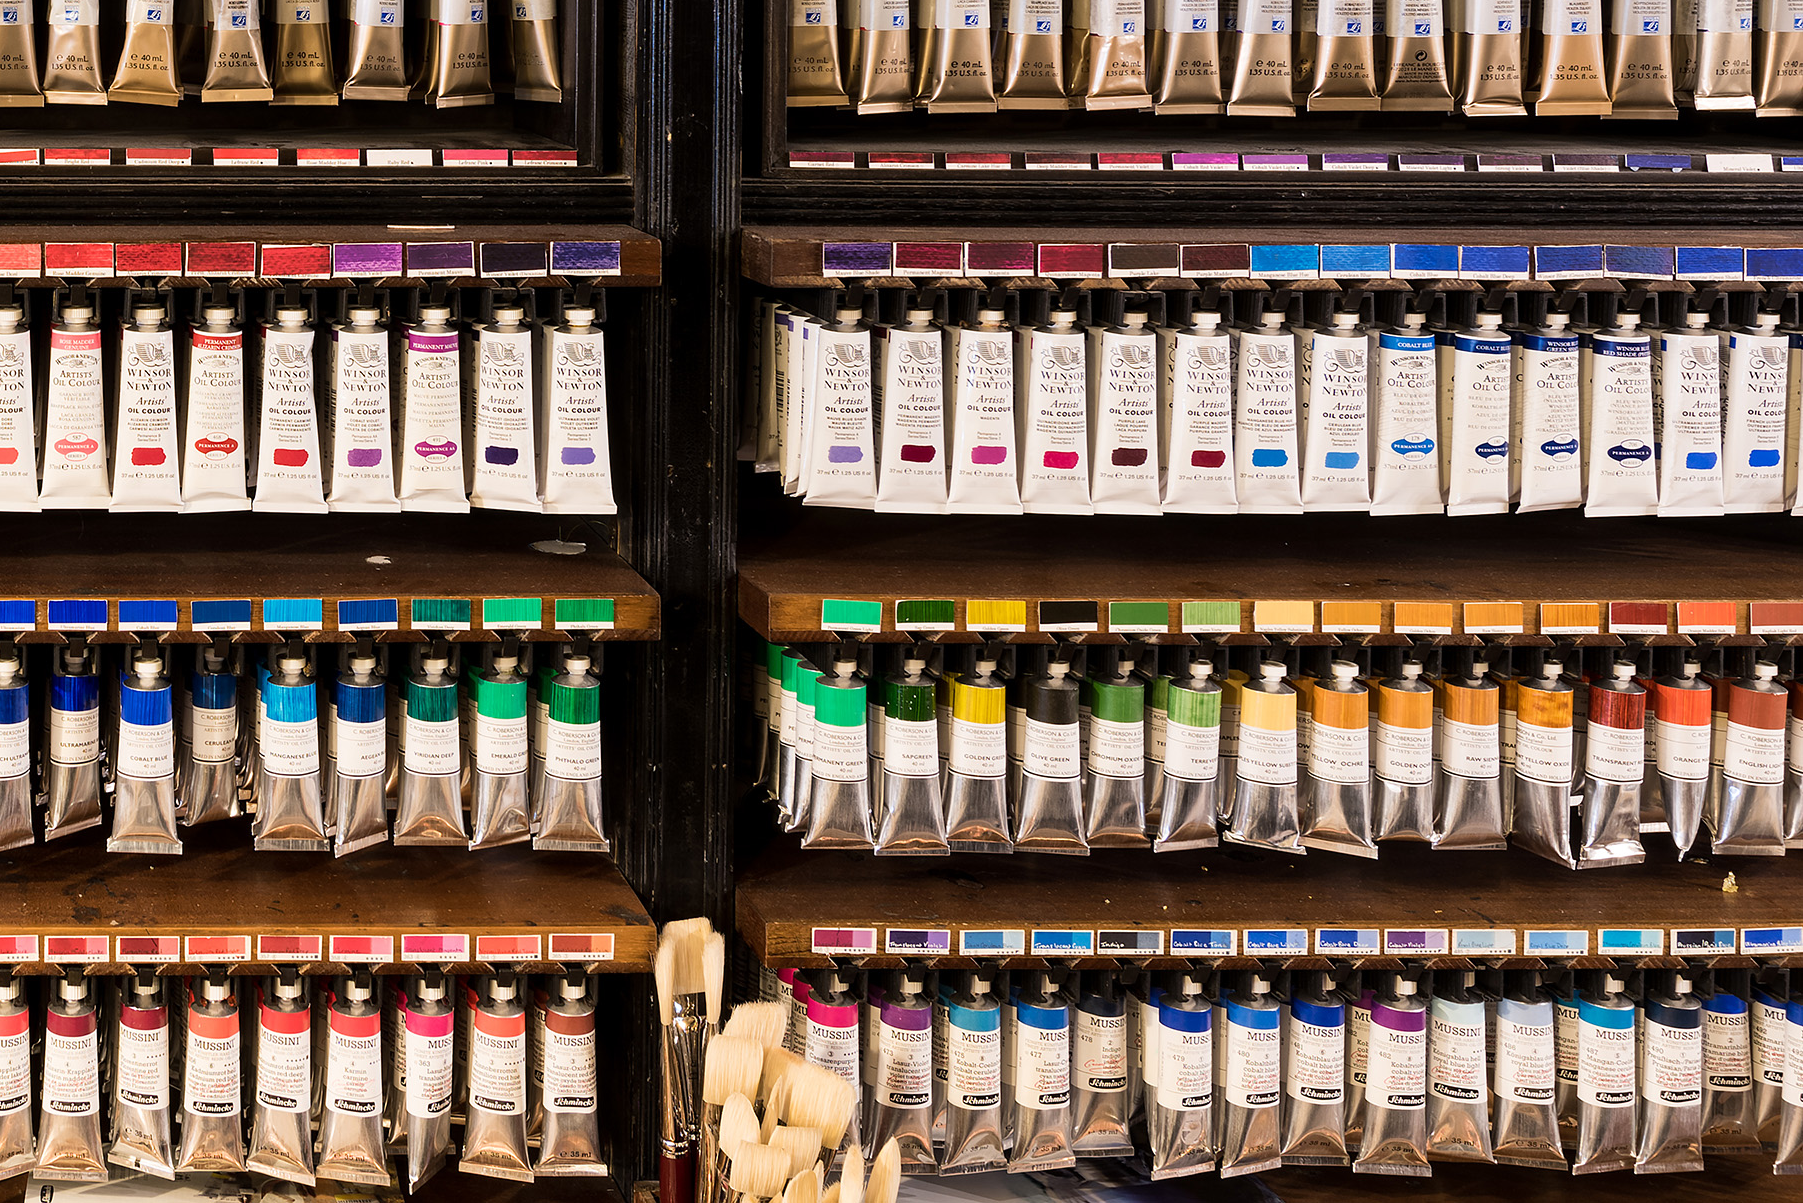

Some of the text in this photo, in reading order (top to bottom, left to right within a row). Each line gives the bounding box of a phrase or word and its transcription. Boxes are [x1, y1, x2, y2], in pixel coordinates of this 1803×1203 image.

[412, 342, 442, 351] PERMANENT
[557, 367, 602, 377] WINSOR
[825, 367, 870, 378] WINSOR
[556, 381, 602, 391] NEWTON
[824, 381, 870, 392] NEWTON
[1031, 752, 1048, 760] OLIVE
[1434, 1020, 1480, 1037] MUSSINI
[1434, 1082, 1479, 1099] Schmincke
